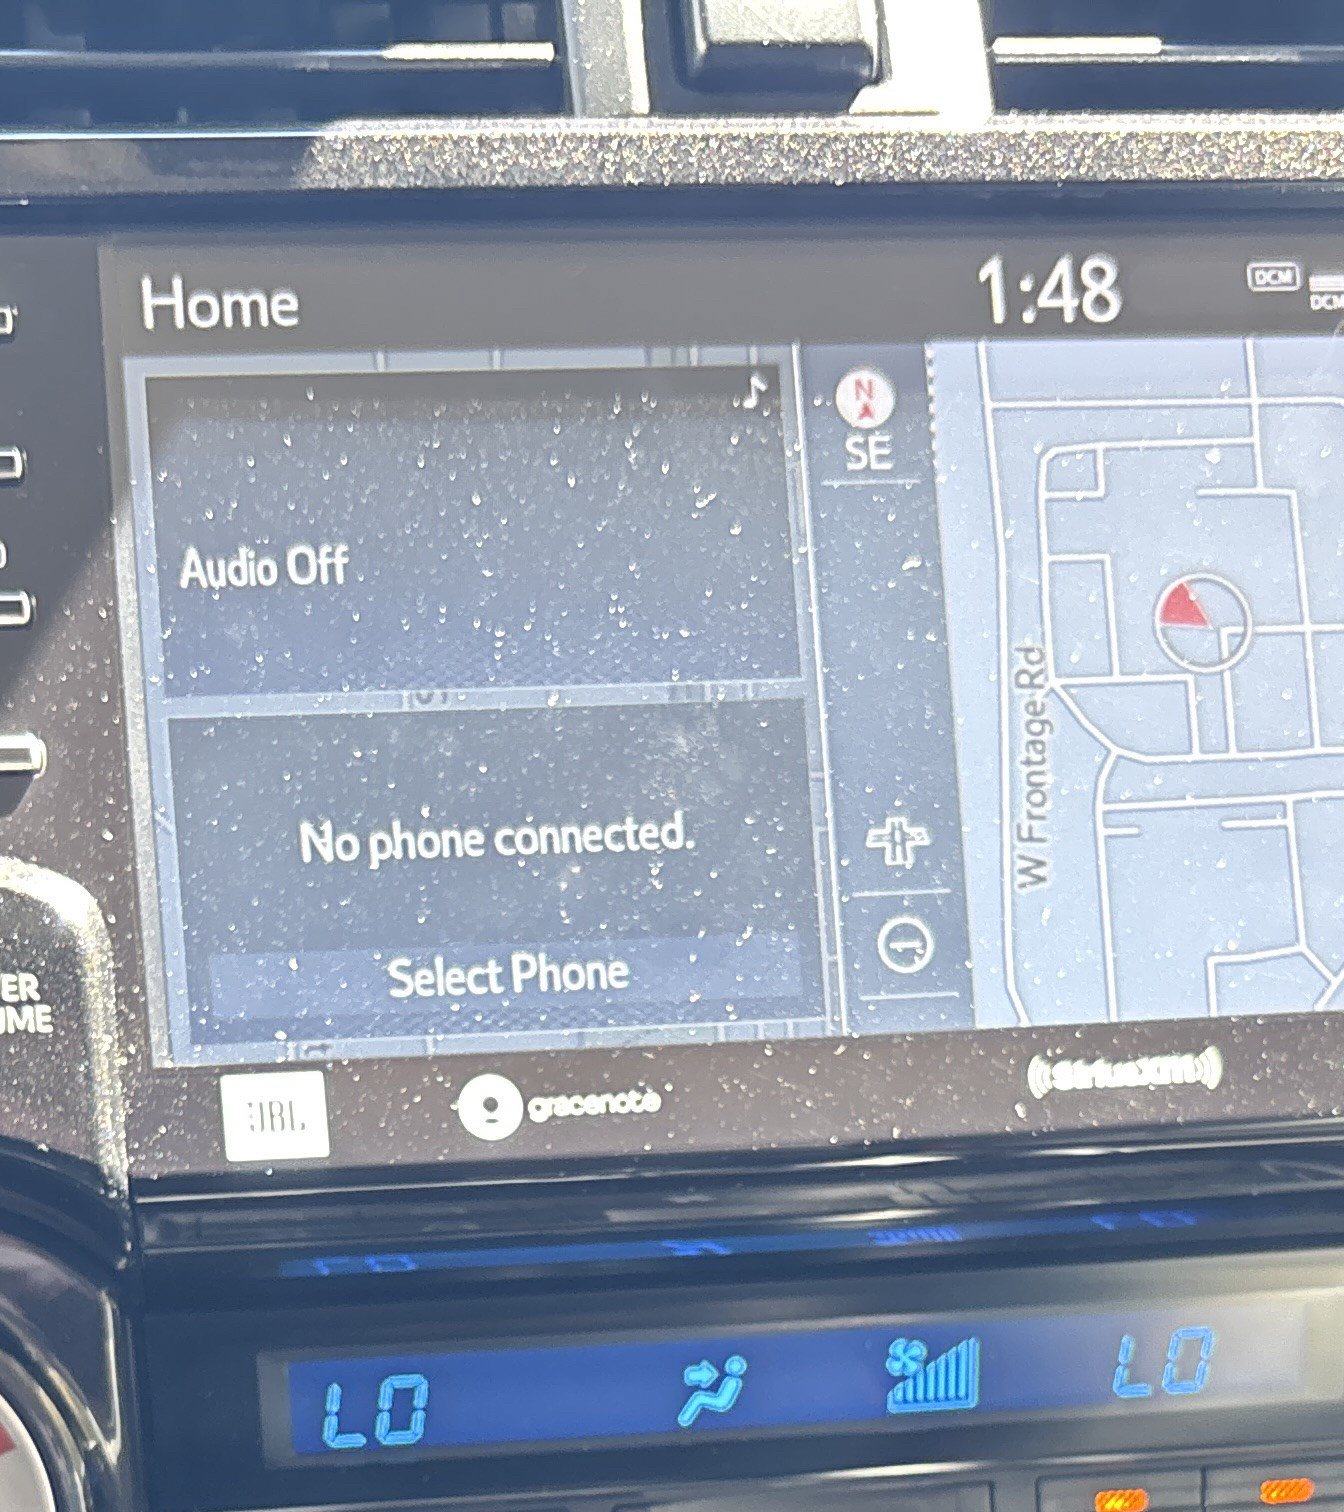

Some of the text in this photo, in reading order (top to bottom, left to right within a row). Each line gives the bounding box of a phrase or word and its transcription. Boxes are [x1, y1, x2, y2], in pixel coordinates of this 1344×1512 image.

[141, 274, 301, 331] Home
[976, 252, 1122, 325] 1:48
[854, 378, 874, 401] N
[845, 433, 894, 471] SE
[179, 544, 349, 589] Audio Off
[1014, 646, 1054, 890] W Frontage Rd
[299, 817, 696, 870] No phone connected.
[388, 951, 630, 999] Select Phone
